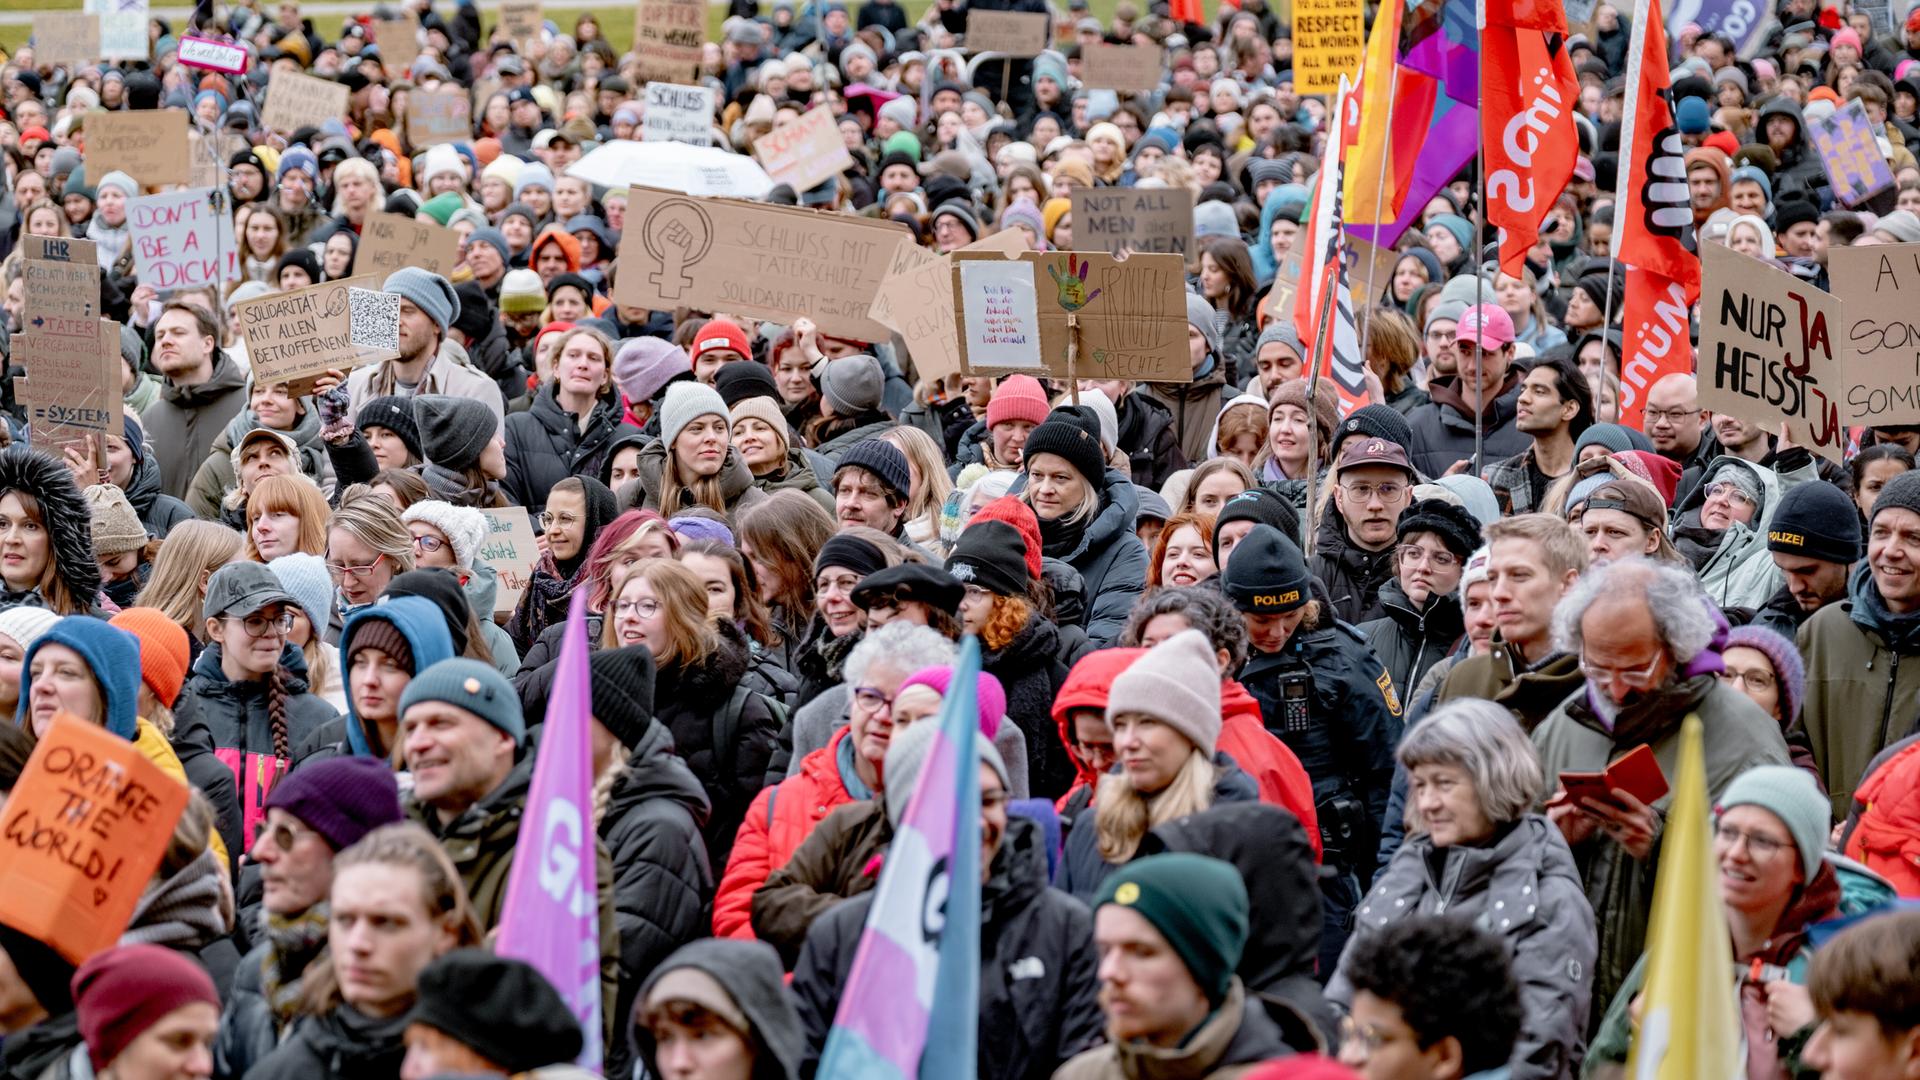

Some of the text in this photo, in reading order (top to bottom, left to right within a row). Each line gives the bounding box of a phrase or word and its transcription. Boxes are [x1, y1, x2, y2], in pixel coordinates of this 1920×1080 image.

[1297, 15, 1359, 32] RESPECT
[1320, 35, 1360, 48] WOMEN
[1327, 54, 1357, 68] WAYS
[1307, 73, 1341, 86] ALWA
[650, 87, 705, 111] SCHLUSS
[132, 199, 202, 229] DON'T
[1083, 194, 1171, 213] NOT ALL
[1088, 216, 1136, 235] MEN
[42, 239, 70, 257] IHR
[137, 230, 199, 258] BE A
[735, 219, 831, 260] SCHLUSS
[841, 239, 878, 265] MIT
[1875, 254, 1899, 292] A
[278, 316, 317, 340] ALLEN
[1720, 288, 1833, 378] NUR JA
[253, 333, 350, 365] BETROFFENEN!
[1104, 352, 1166, 378] RECHTE
[1715, 341, 1818, 419] HEISST
[48, 404, 111, 425] SYSTEM
[1809, 388, 1841, 448] JA
[1253, 590, 1300, 607] POLIZEI
[43, 745, 162, 826] ORANGE
[55, 786, 120, 841] THE
[5, 809, 124, 883] WORLD!
